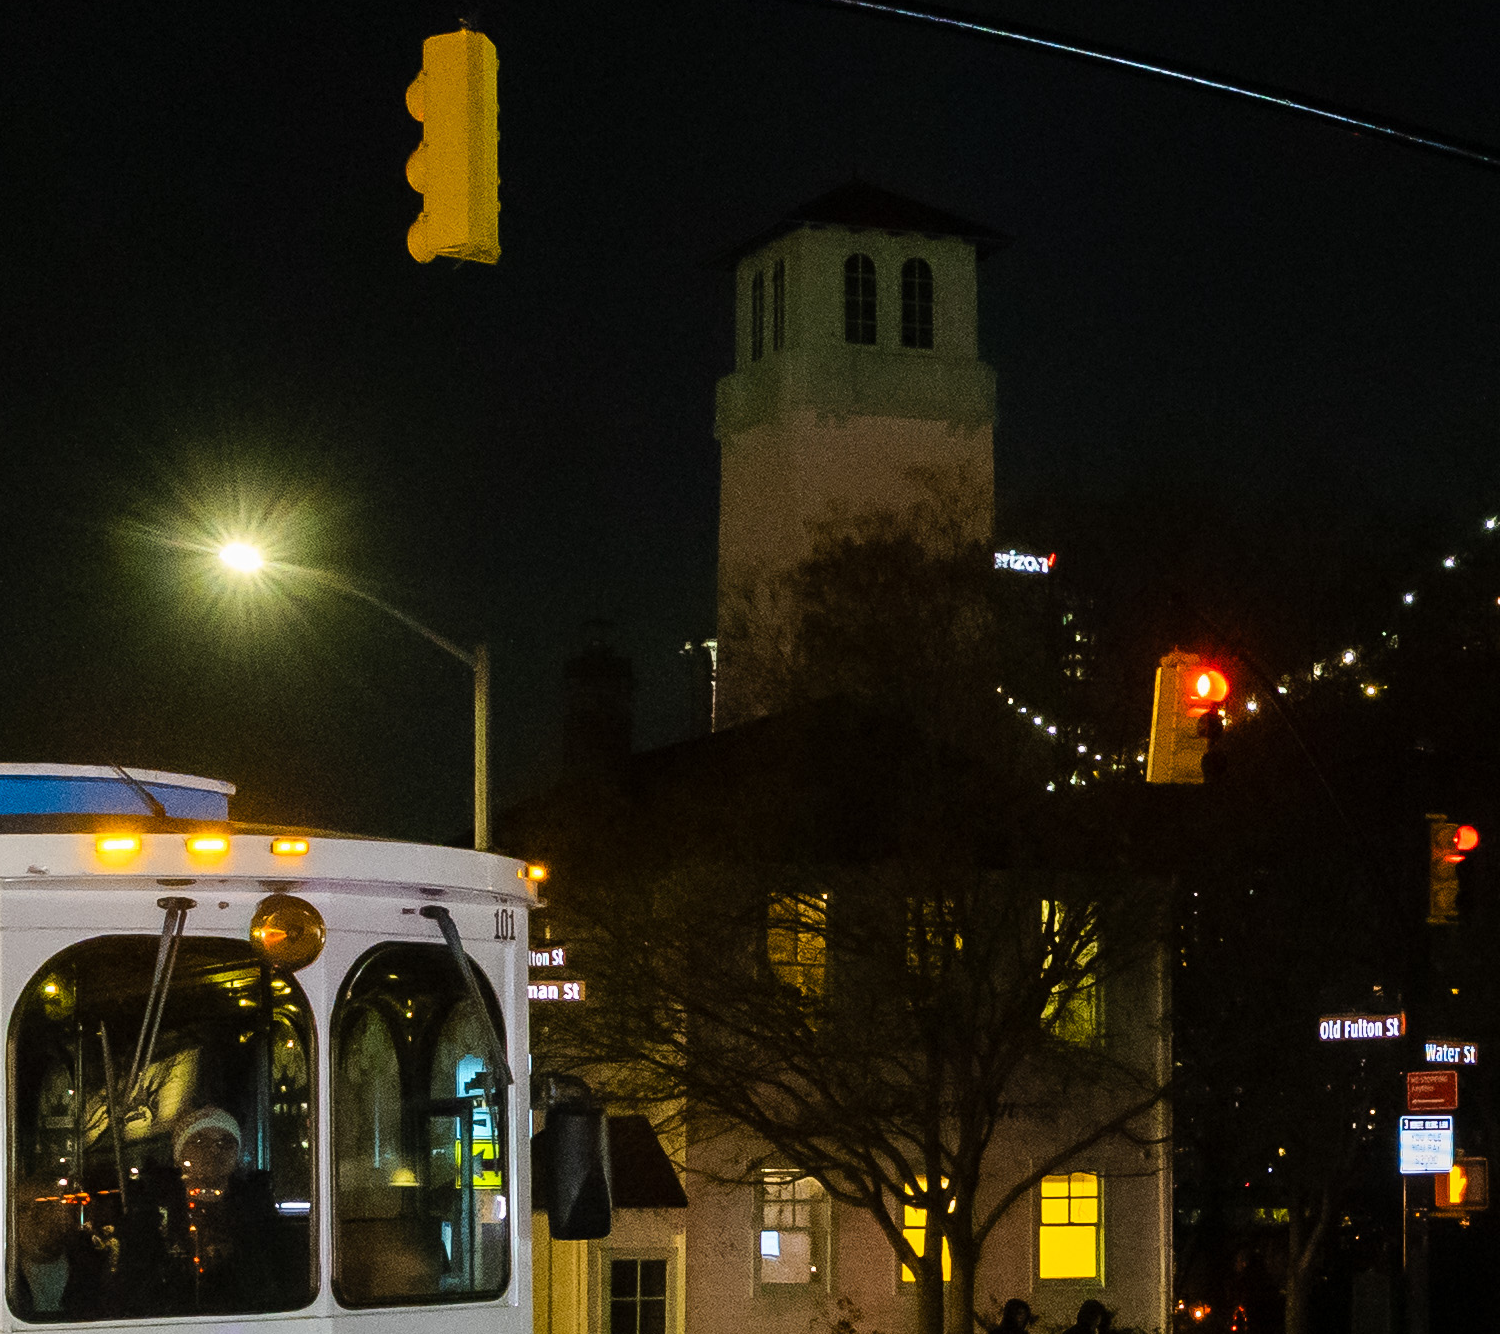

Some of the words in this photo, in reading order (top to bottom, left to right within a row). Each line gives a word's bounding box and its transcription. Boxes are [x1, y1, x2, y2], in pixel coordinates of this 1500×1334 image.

[494, 908, 516, 941] 101
[552, 948, 564, 966] St
[563, 982, 580, 1000] St
[1319, 1020, 1341, 1039] Old
[1344, 1019, 1383, 1039] Fulton
[1386, 1018, 1400, 1037] St
[1425, 1043, 1460, 1063] Water
[1464, 1045, 1476, 1064] St
